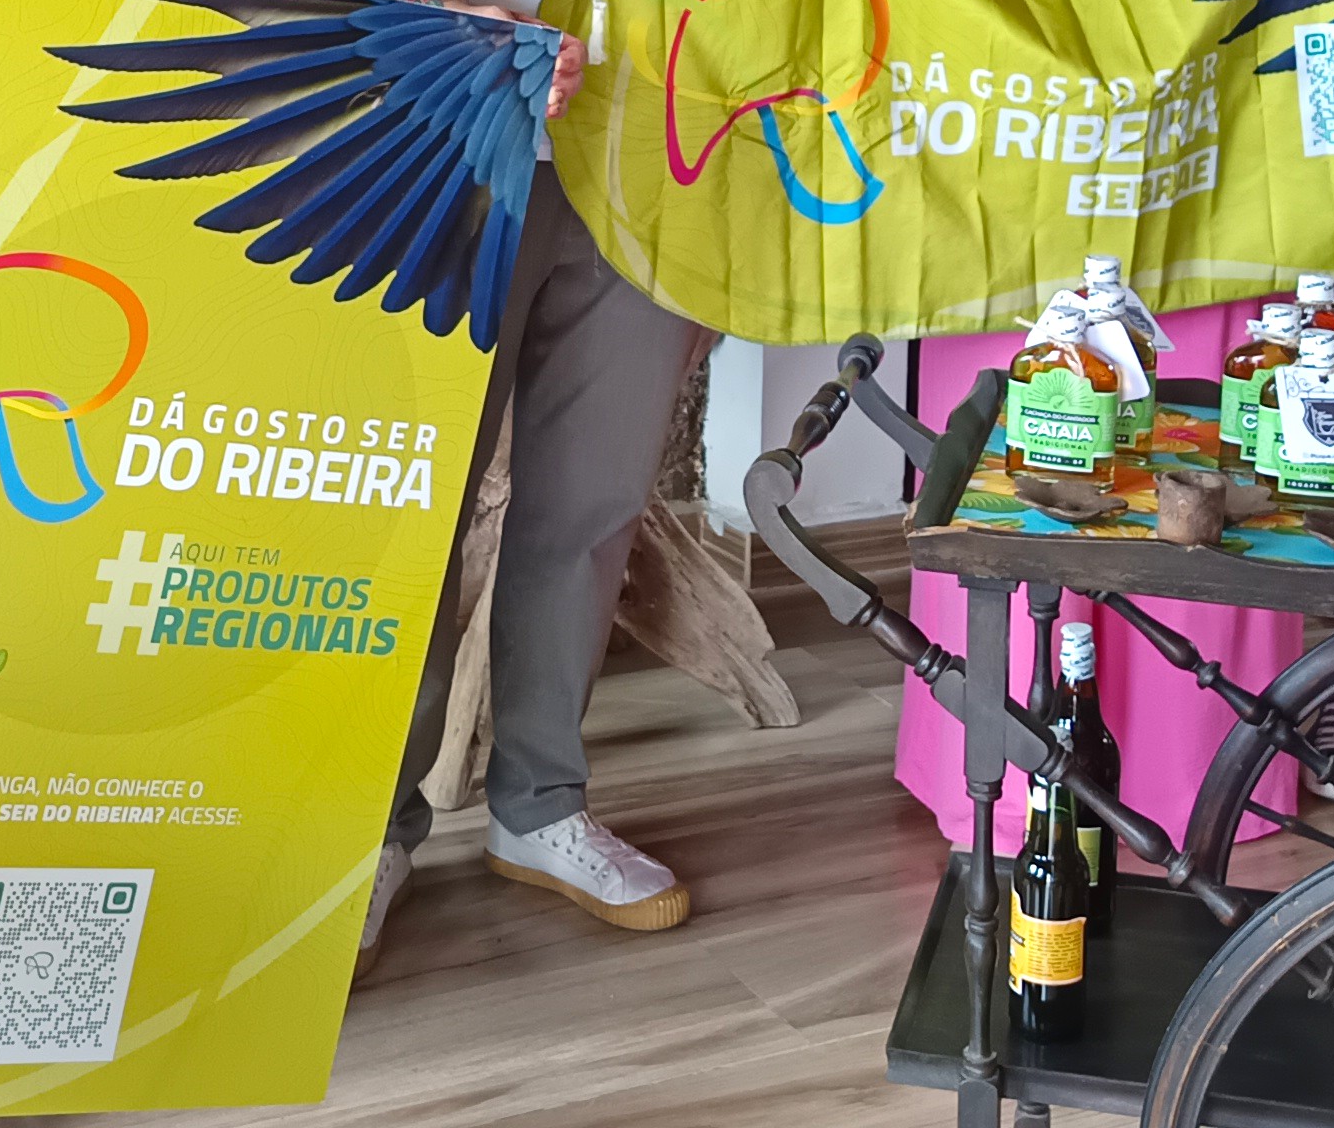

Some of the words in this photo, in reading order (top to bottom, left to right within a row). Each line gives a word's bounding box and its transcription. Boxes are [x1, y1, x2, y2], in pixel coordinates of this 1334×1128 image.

[890, 52, 948, 93] DÁ
[969, 68, 1137, 108] GOSTO
[1154, 52, 1218, 100] SER
[890, 100, 976, 157] DO
[993, 86, 1219, 163] RIBEIRA
[1078, 151, 1213, 213] SEBRAE
[128, 391, 186, 431] DÁ
[203, 404, 346, 445] GOSTO
[359, 418, 438, 453] SER
[1024, 417, 1093, 441] CATAIA
[115, 433, 205, 491] DO
[216, 442, 433, 510] RIBEIRA
[169, 542, 225, 564] AQUI
[236, 546, 281, 567] TEM
[160, 567, 373, 611] PRODUTOS
[150, 606, 399, 656] REGIONAIS
[47, 773, 89, 797] NÃO
[95, 777, 184, 799] CONHECE
[188, 780, 204, 799] O
[42, 804, 72, 823] DO
[75, 805, 164, 824] RIBEIRA?
[167, 807, 243, 826] ACESSE:
